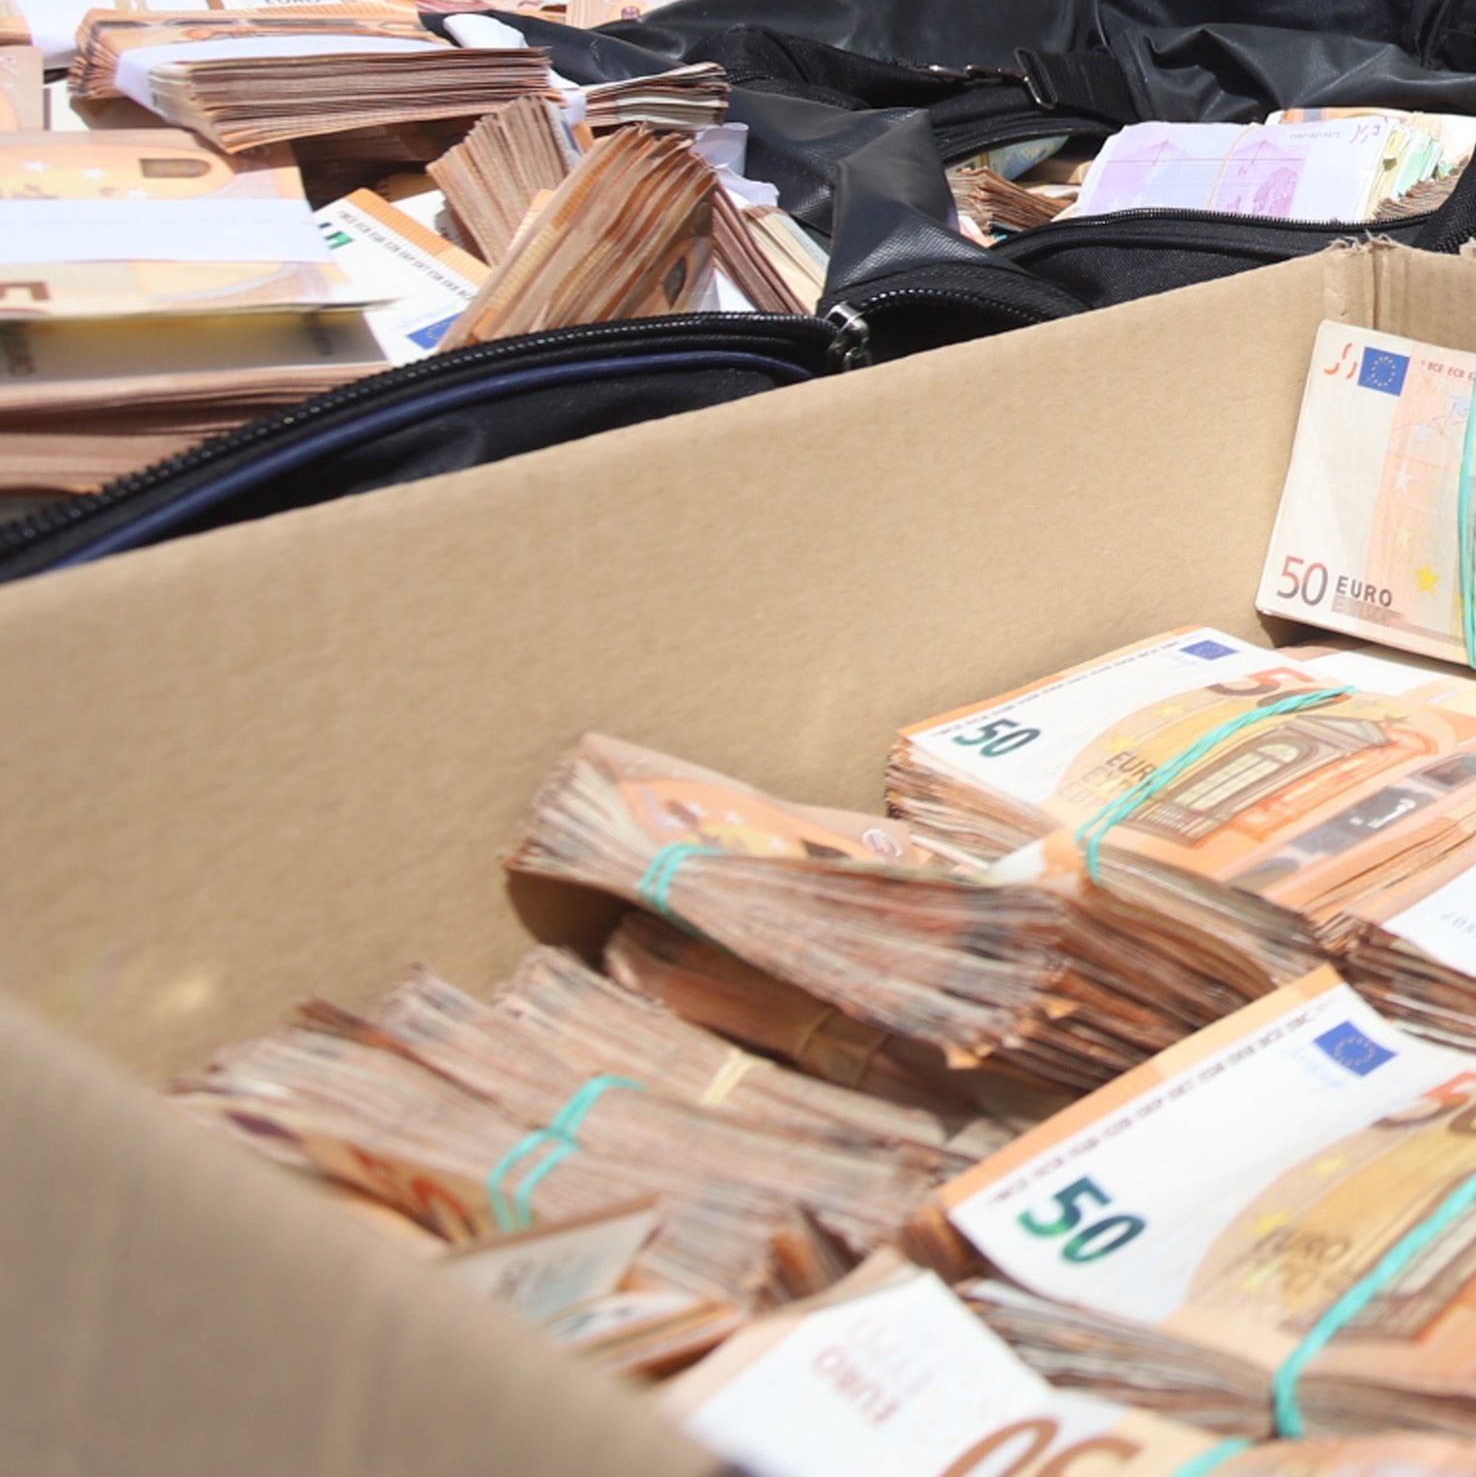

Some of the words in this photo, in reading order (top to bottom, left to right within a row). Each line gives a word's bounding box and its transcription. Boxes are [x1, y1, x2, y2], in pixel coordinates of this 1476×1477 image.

[1276, 555, 1329, 606] 50
[1335, 575, 1393, 607] EURO
[952, 718, 1042, 758] 50
[1104, 750, 1162, 782] EUR
[1017, 1175, 1147, 1265] 50
